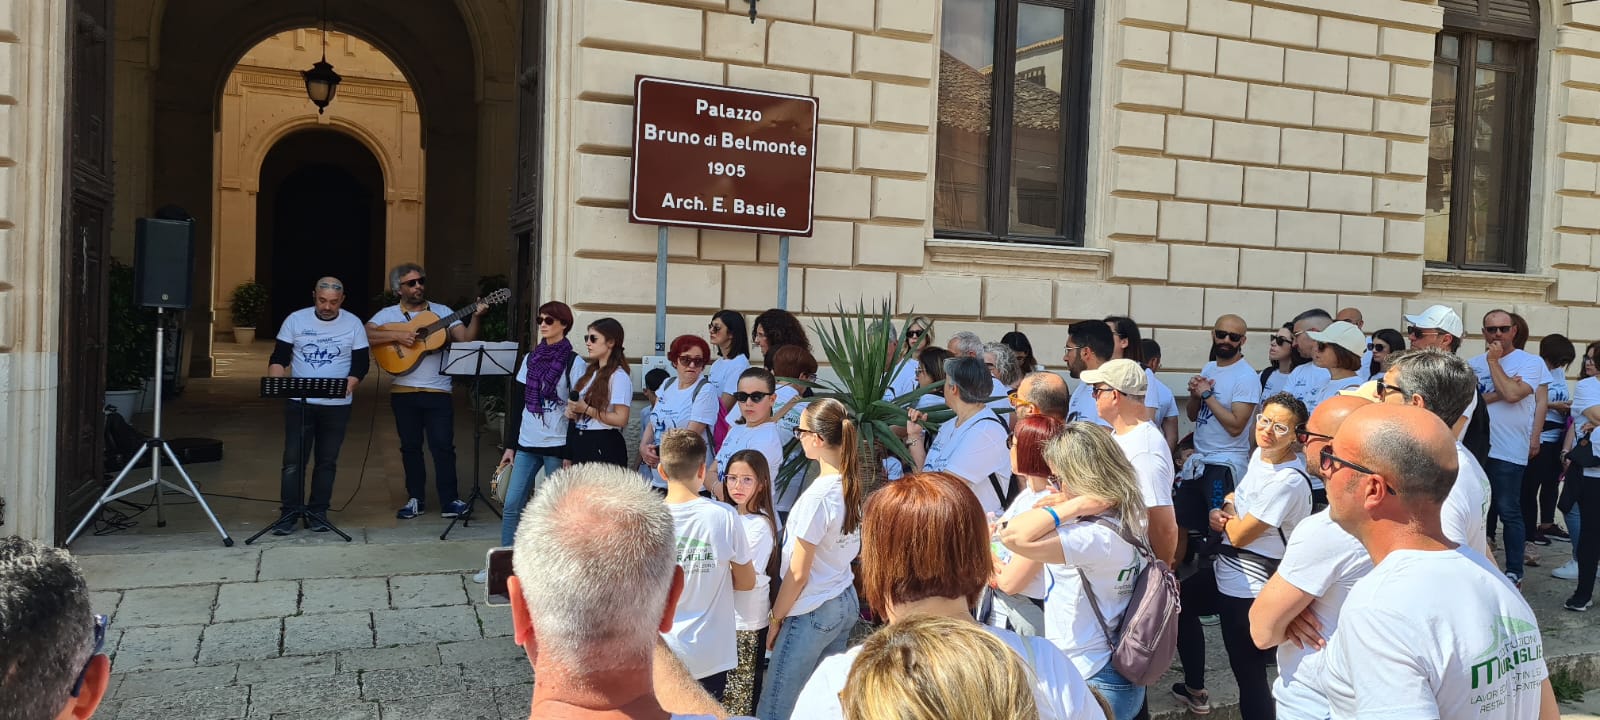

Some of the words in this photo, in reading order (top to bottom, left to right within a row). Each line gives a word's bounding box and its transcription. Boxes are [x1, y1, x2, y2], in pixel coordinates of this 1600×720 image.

[696, 99, 762, 122] Palazzo
[644, 123, 700, 145] Bruno
[704, 134, 717, 147] di
[721, 132, 807, 156] Belmonte
[707, 162, 746, 178] 1905
[661, 192, 708, 211] Arch.
[712, 197, 728, 213] E.
[733, 199, 786, 218] Basile
